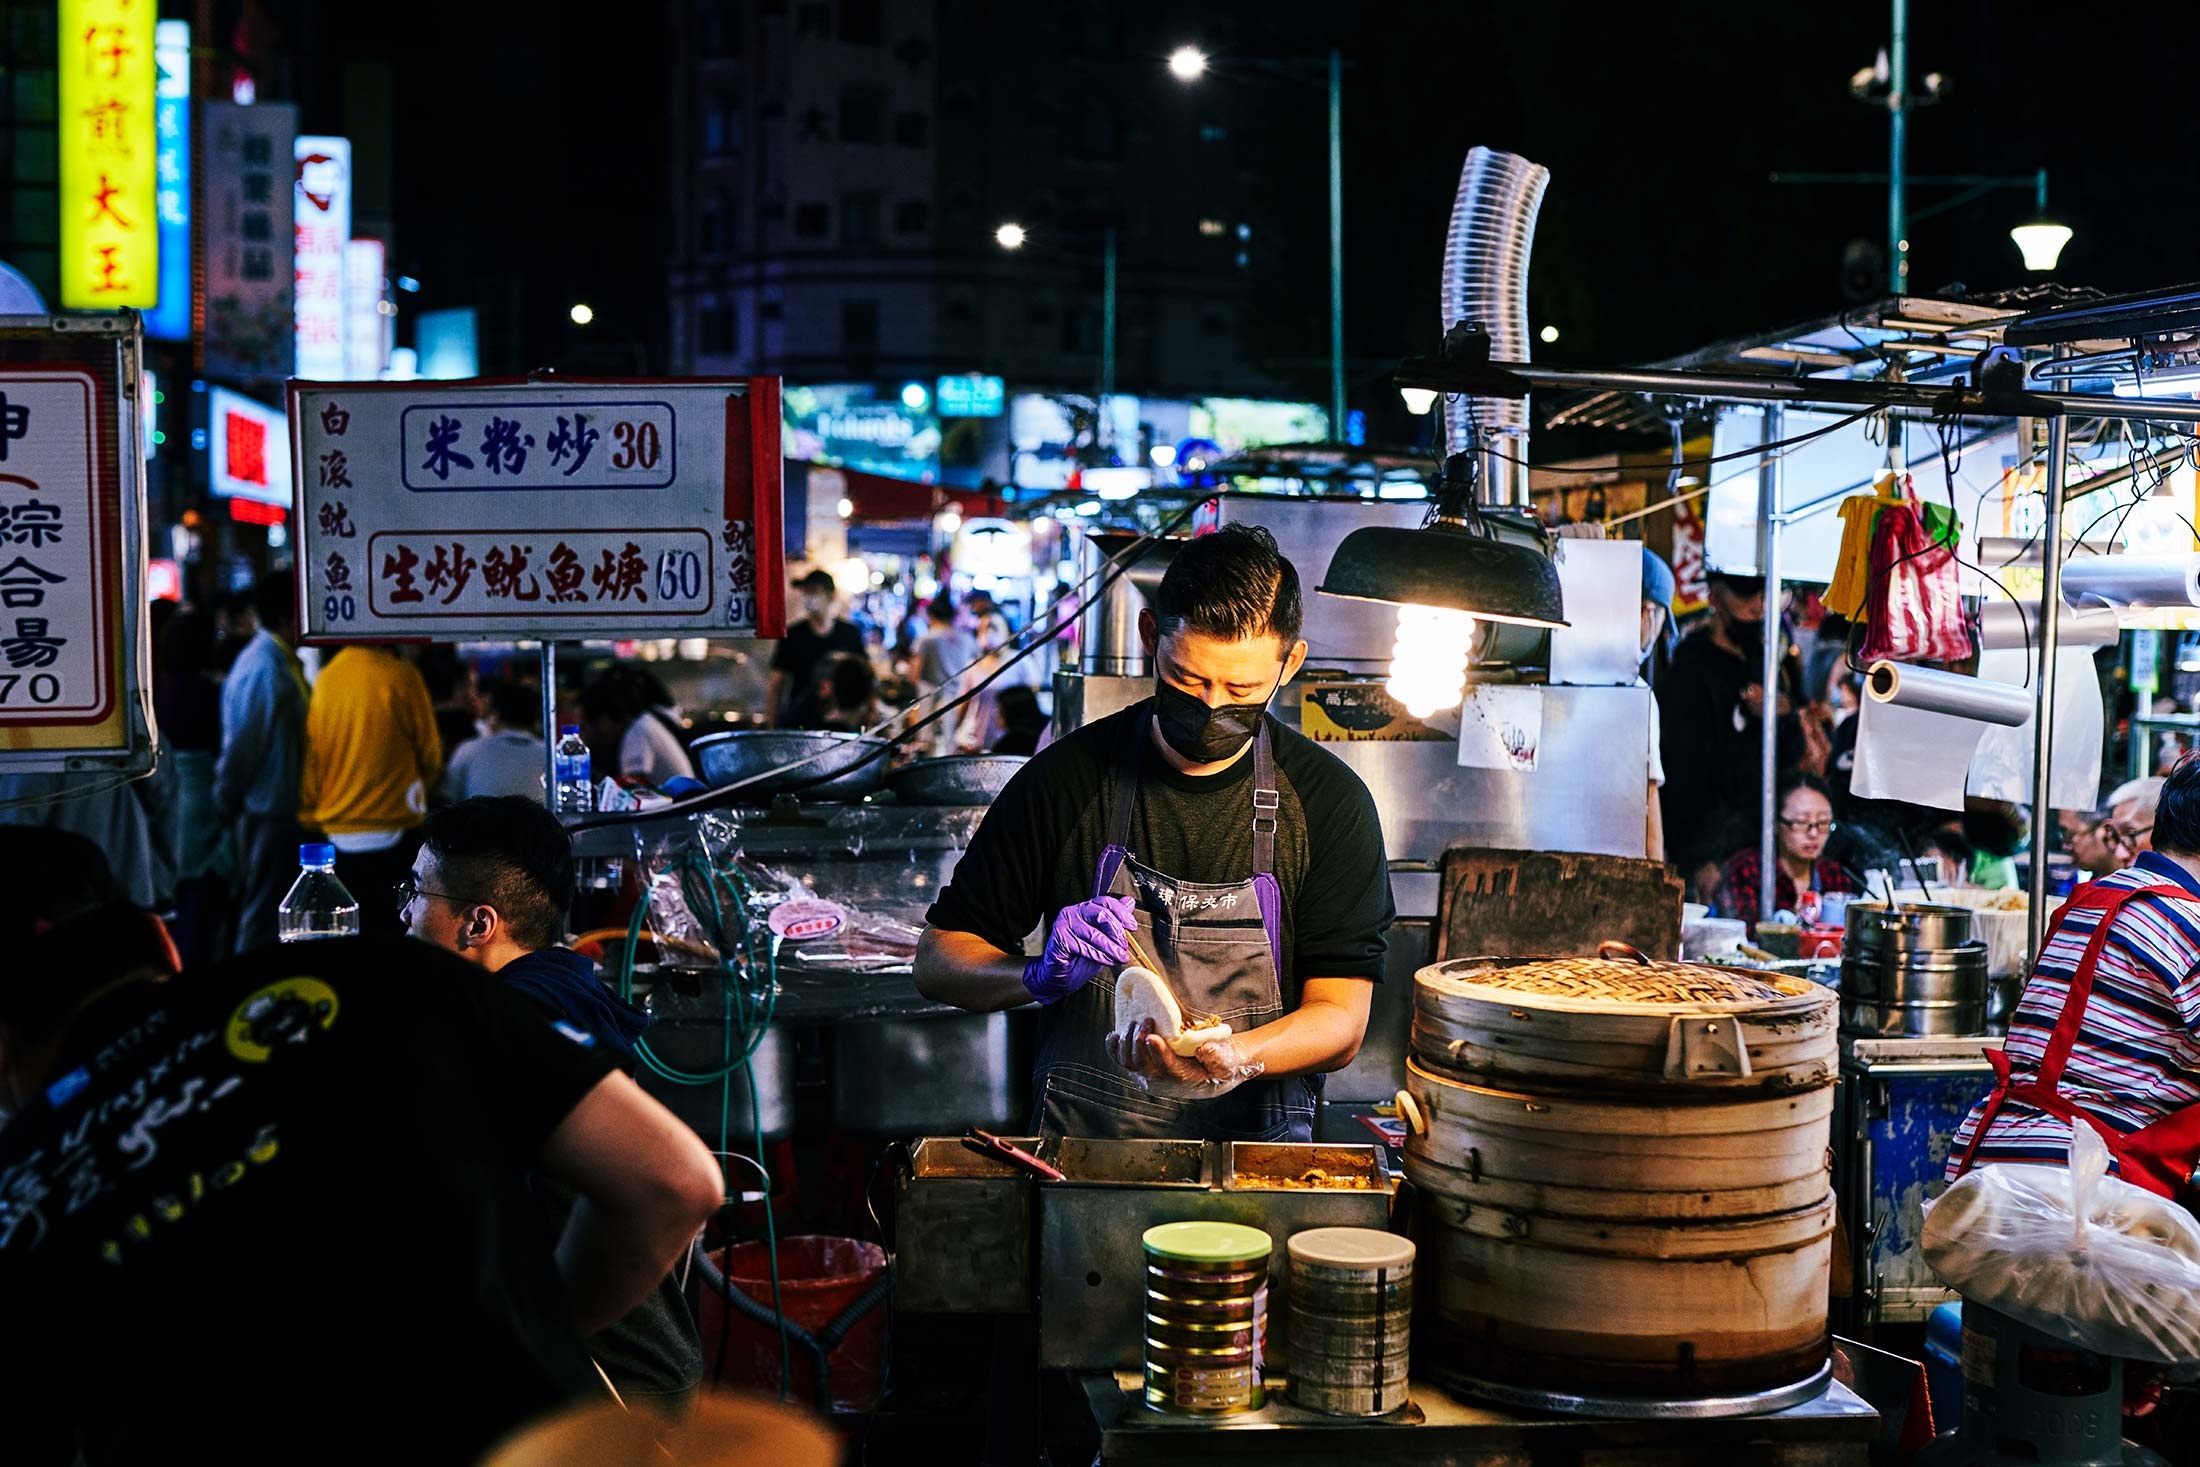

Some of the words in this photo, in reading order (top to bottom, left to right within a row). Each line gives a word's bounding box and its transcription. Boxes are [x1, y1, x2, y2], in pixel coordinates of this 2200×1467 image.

[80, 0, 131, 294] 仔煎大王
[421, 412, 600, 480] 米粉炒
[612, 420, 661, 469] 30
[318, 402, 357, 592] 白滾魷魚
[657, 550, 703, 601] 60
[325, 595, 355, 622] 90
[729, 597, 757, 623] 90
